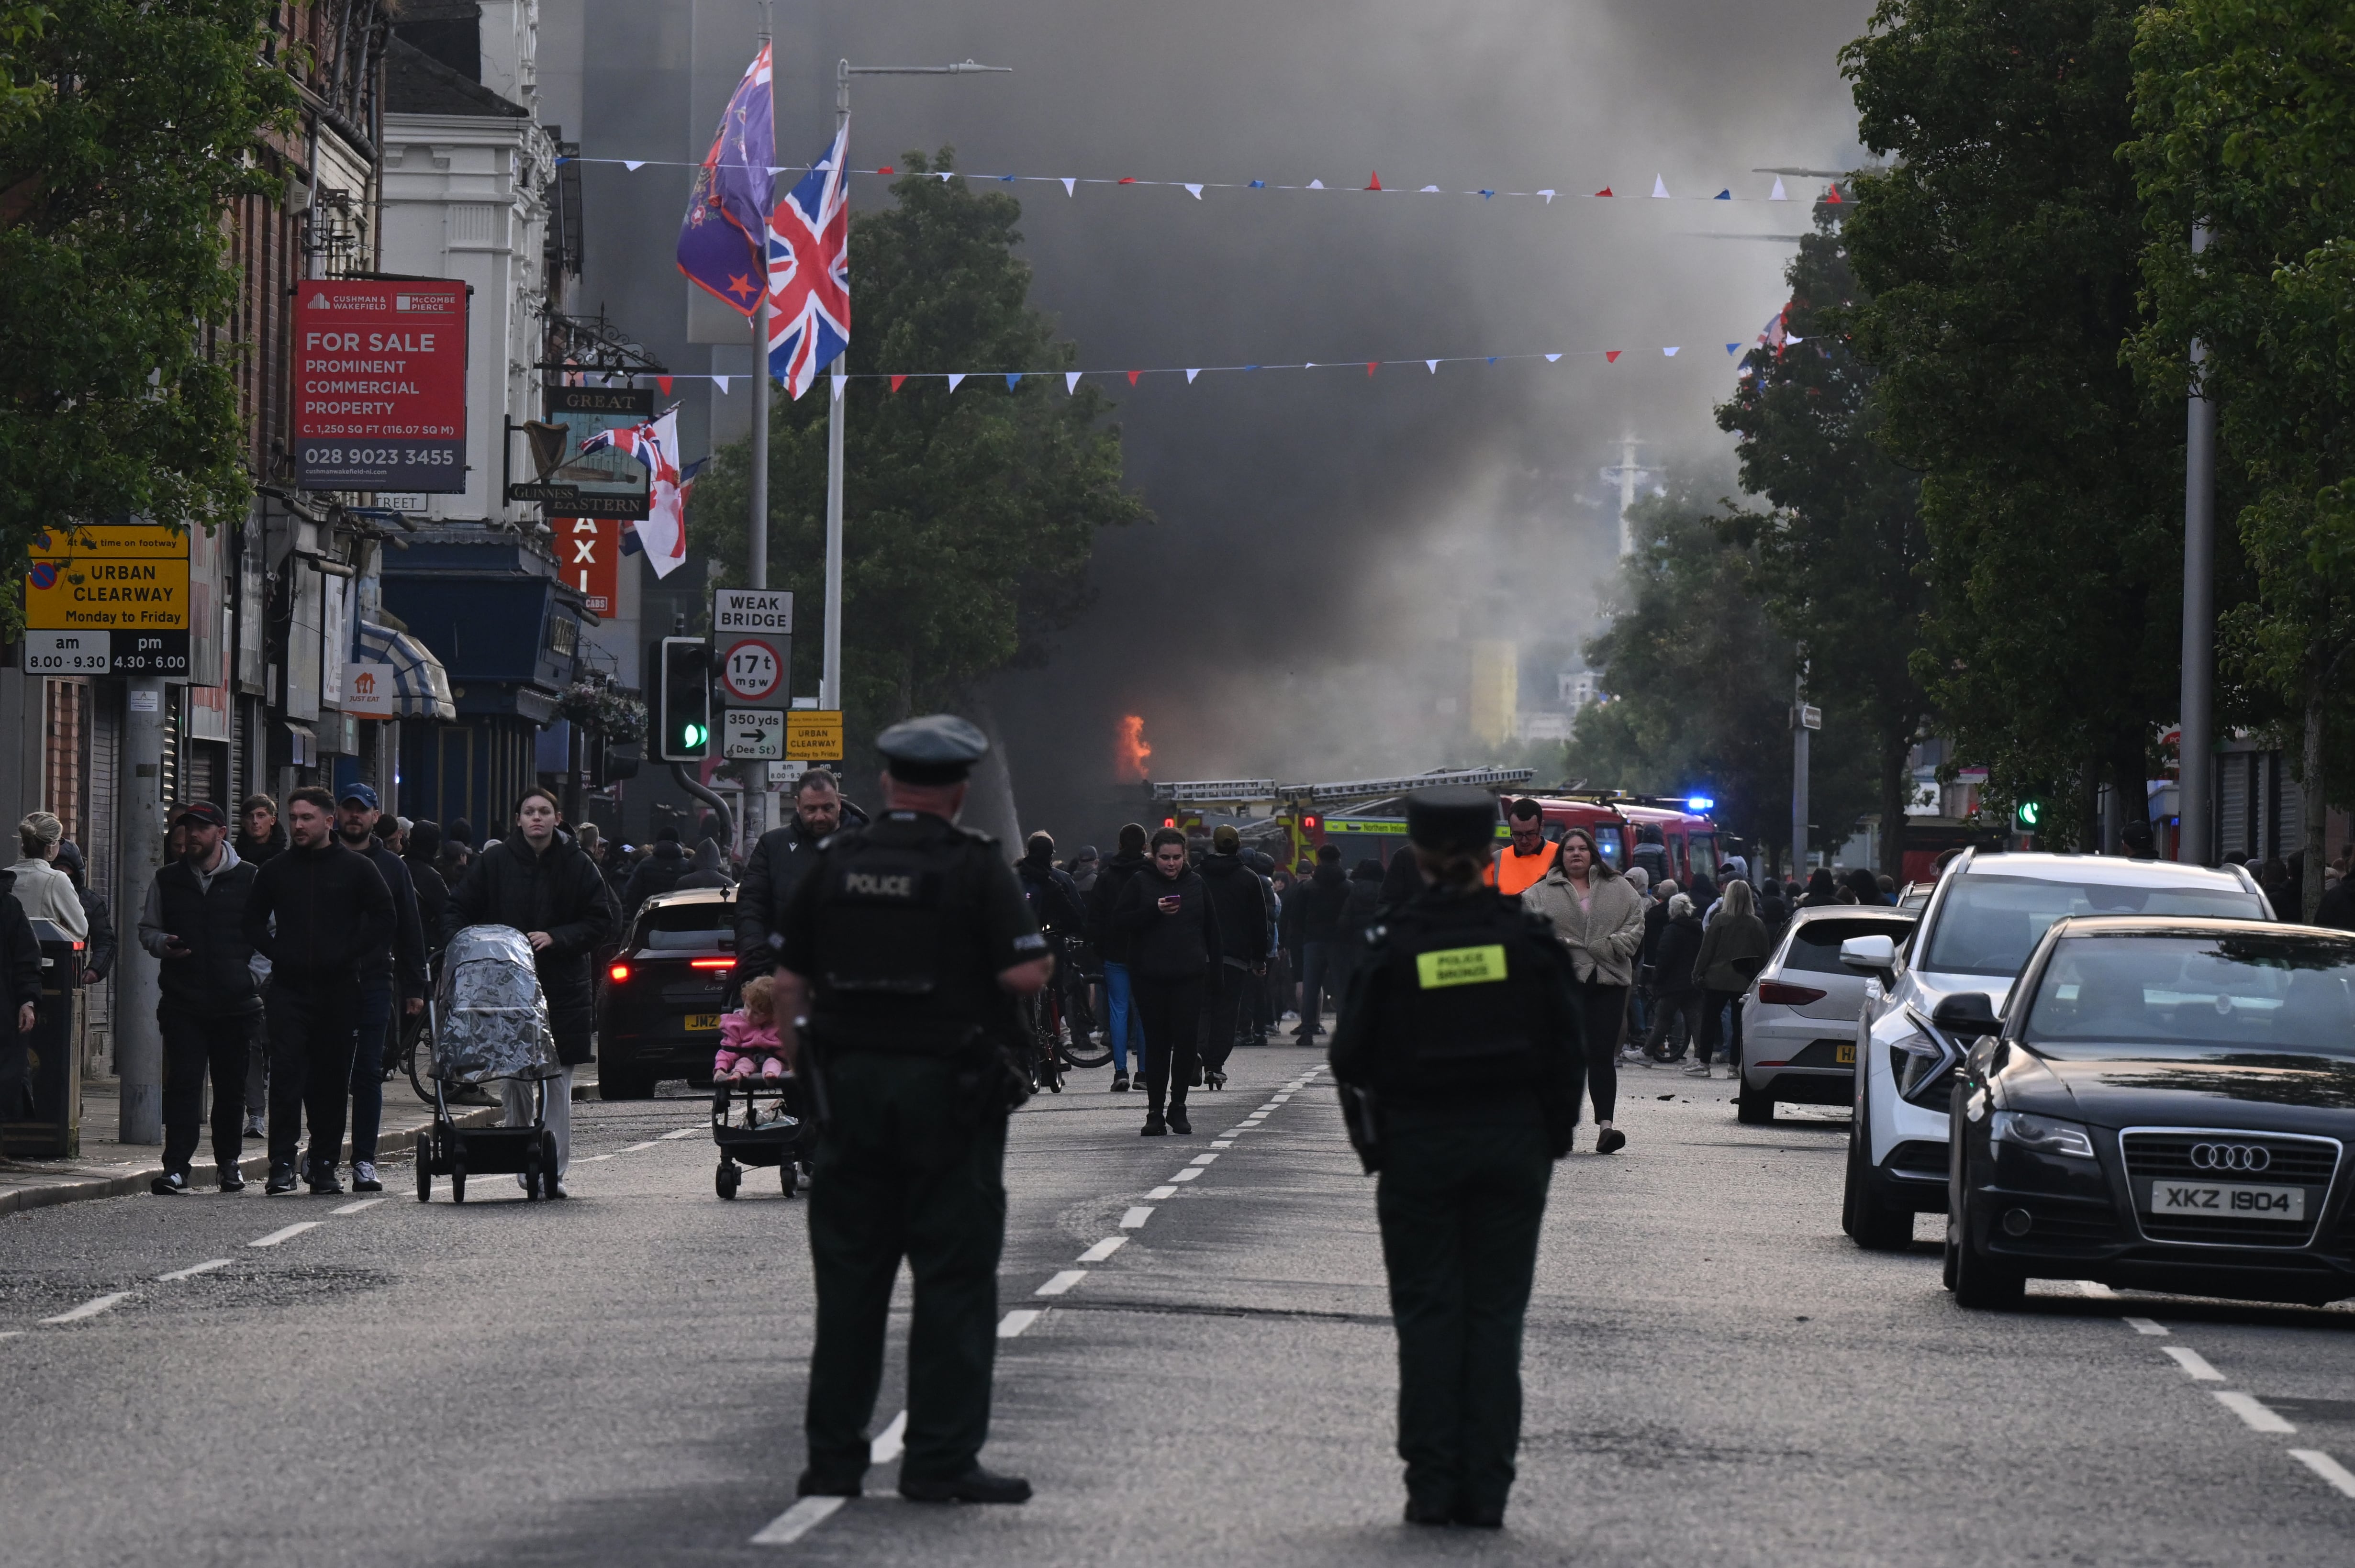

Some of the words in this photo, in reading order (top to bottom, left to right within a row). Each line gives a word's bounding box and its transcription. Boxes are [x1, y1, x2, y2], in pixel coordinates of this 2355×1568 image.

[307, 333, 359, 351] FOR
[369, 334, 435, 352] SALE
[306, 360, 406, 373] PROMINENT
[306, 381, 420, 394] COMMERCIAL
[305, 401, 395, 414] PROPERTY
[567, 394, 636, 408] GREAT
[303, 424, 313, 433] C.
[317, 425, 344, 434] 1,250
[383, 425, 419, 434] (116.07
[422, 426, 437, 434] SQ
[441, 426, 454, 435] M)
[305, 449, 342, 464] 028
[349, 449, 398, 464] 9023
[405, 450, 453, 465] 3455
[515, 486, 573, 499] GUINNESS
[376, 497, 417, 508] TREET
[139, 539, 177, 548] footway
[572, 518, 598, 593] AXI
[91, 566, 156, 580] URBAN
[74, 588, 173, 601] CLEARWAY
[586, 600, 605, 608] CABS
[730, 596, 779, 610] WEAK
[66, 611, 117, 624] Monday
[122, 612, 135, 622] to
[141, 611, 181, 624] Friday
[722, 612, 786, 627] BRIDGE
[56, 638, 79, 649] am
[138, 638, 162, 651] pm
[30, 656, 62, 668] 8.00
[74, 656, 105, 668] 9.30
[114, 656, 145, 668] 4.30
[156, 656, 185, 668] 6.00
[729, 714, 755, 724] 350
[758, 715, 779, 726] yds
[759, 745, 776, 755] St)
[846, 873, 911, 897] POLICE
[691, 1016, 716, 1027] JMZ
[2166, 1189, 2219, 1208] XKZ
[2231, 1191, 2289, 1212] 1904
